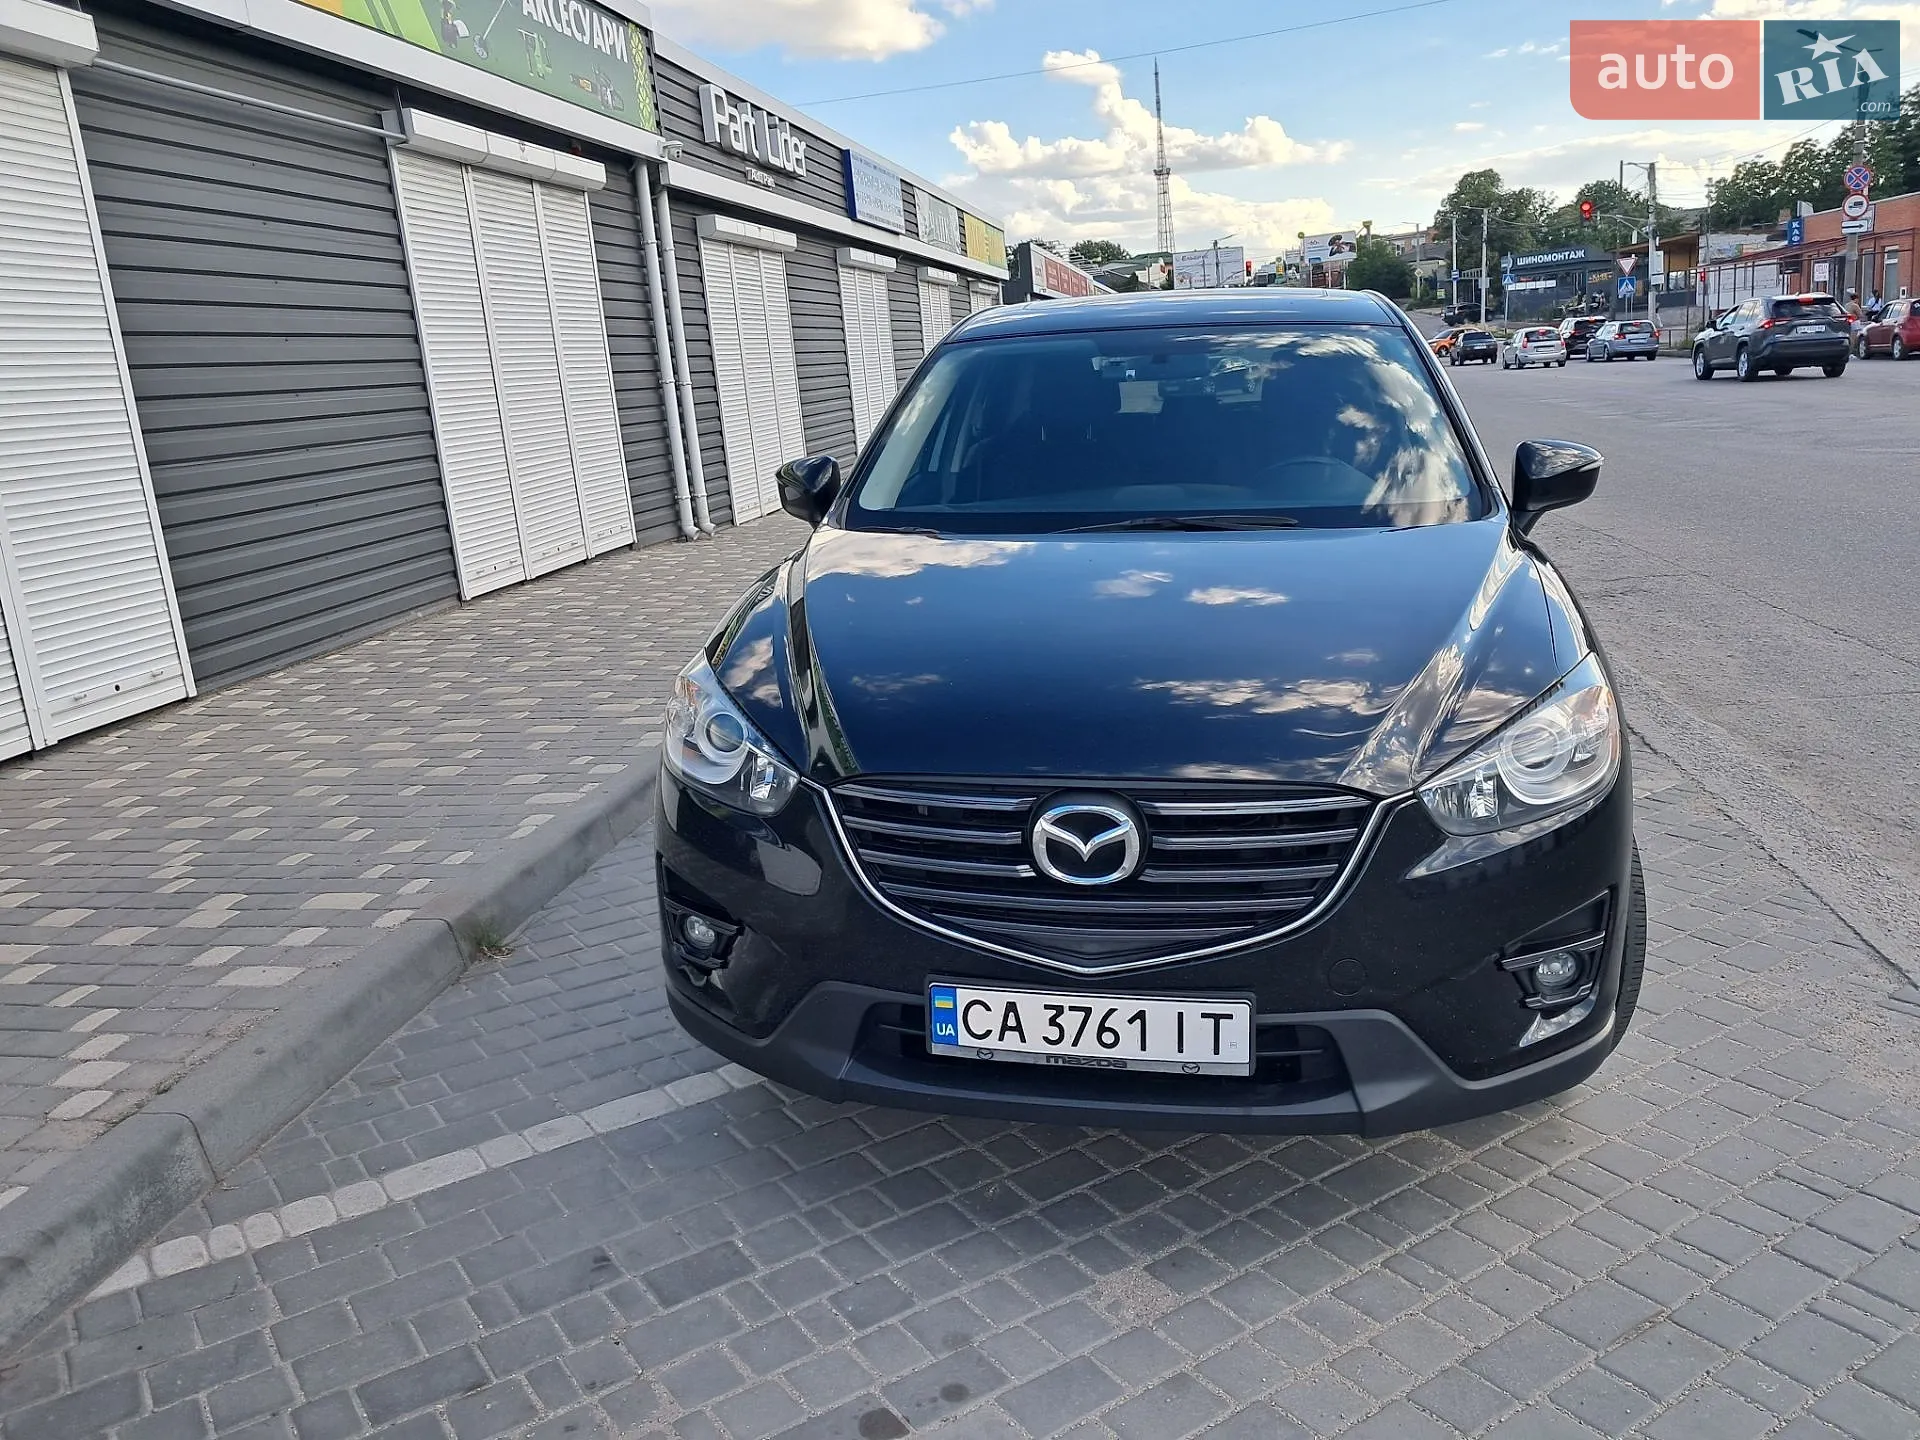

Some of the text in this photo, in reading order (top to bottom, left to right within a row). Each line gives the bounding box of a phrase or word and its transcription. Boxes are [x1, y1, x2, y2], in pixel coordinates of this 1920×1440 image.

[702, 84, 760, 160] Part
[755, 110, 807, 177] Lider
[1791, 221, 1801, 245] КАФ
[1516, 249, 1586, 266] ШИНОМОНТАЖ
[936, 1022, 956, 1037] UA
[961, 998, 1234, 1056] CA 3761 IT
